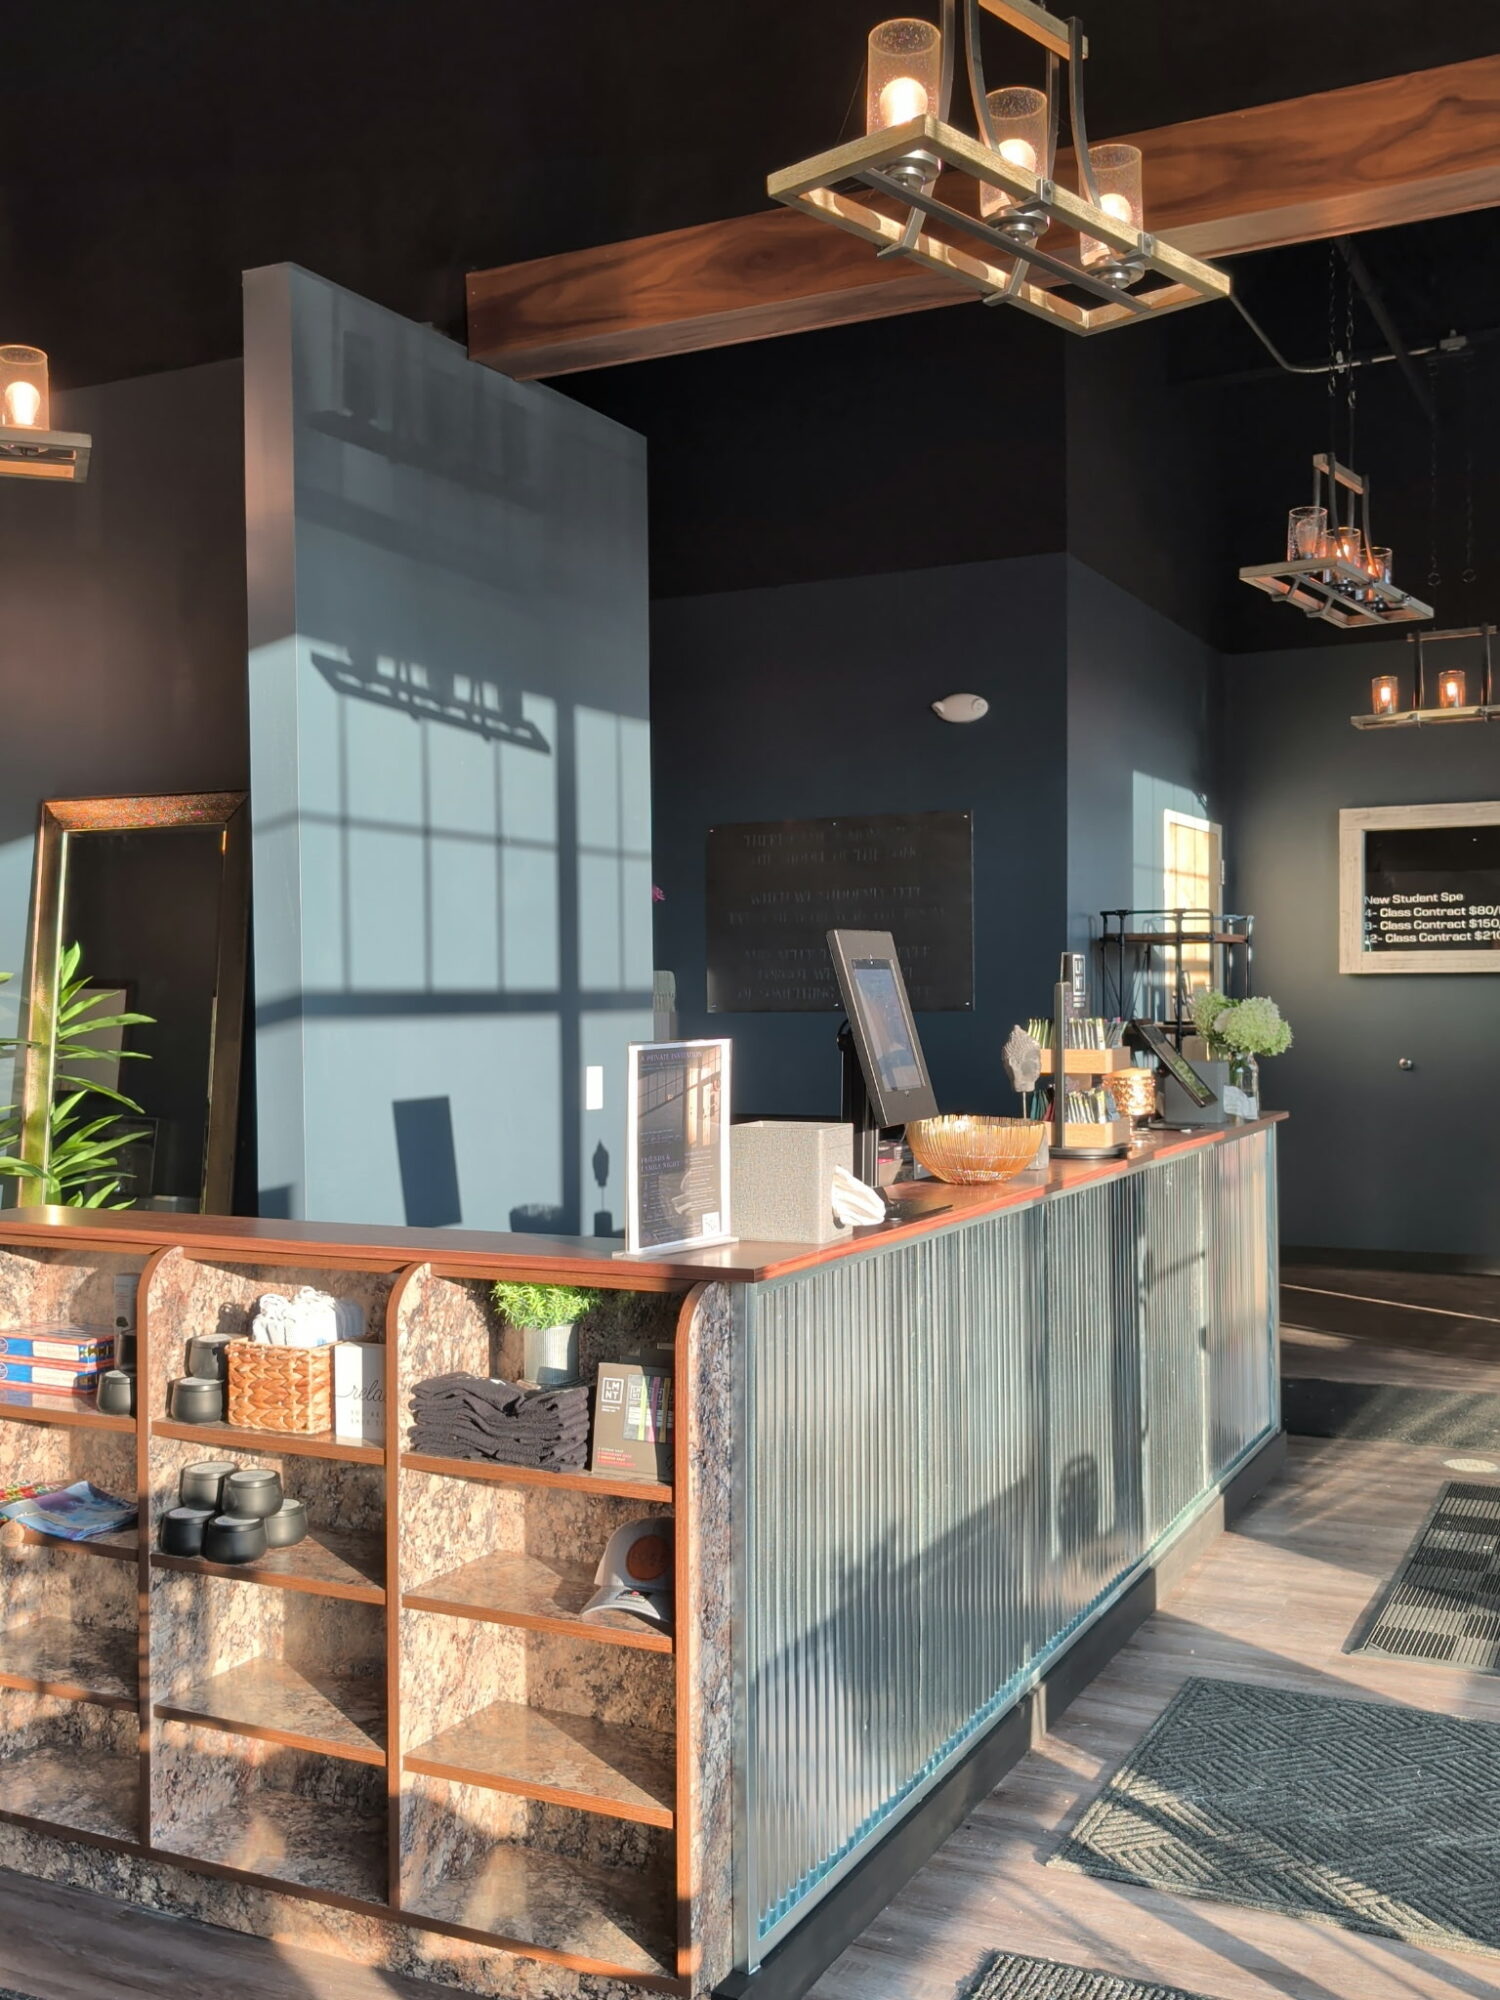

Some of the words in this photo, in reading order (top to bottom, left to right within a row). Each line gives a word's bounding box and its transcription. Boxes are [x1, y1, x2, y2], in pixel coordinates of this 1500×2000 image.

[1364, 895, 1390, 905] New
[1392, 893, 1439, 904] Student
[1440, 892, 1464, 903] Spe
[1380, 907, 1412, 918] Class
[1413, 906, 1466, 917] Contract
[1469, 905, 1500, 917] $80/
[1380, 920, 1412, 931] Class
[1413, 919, 1466, 930] Contract
[1469, 918, 1500, 929] $150
[1385, 933, 1417, 944] Class
[1418, 931, 1472, 943] Contract
